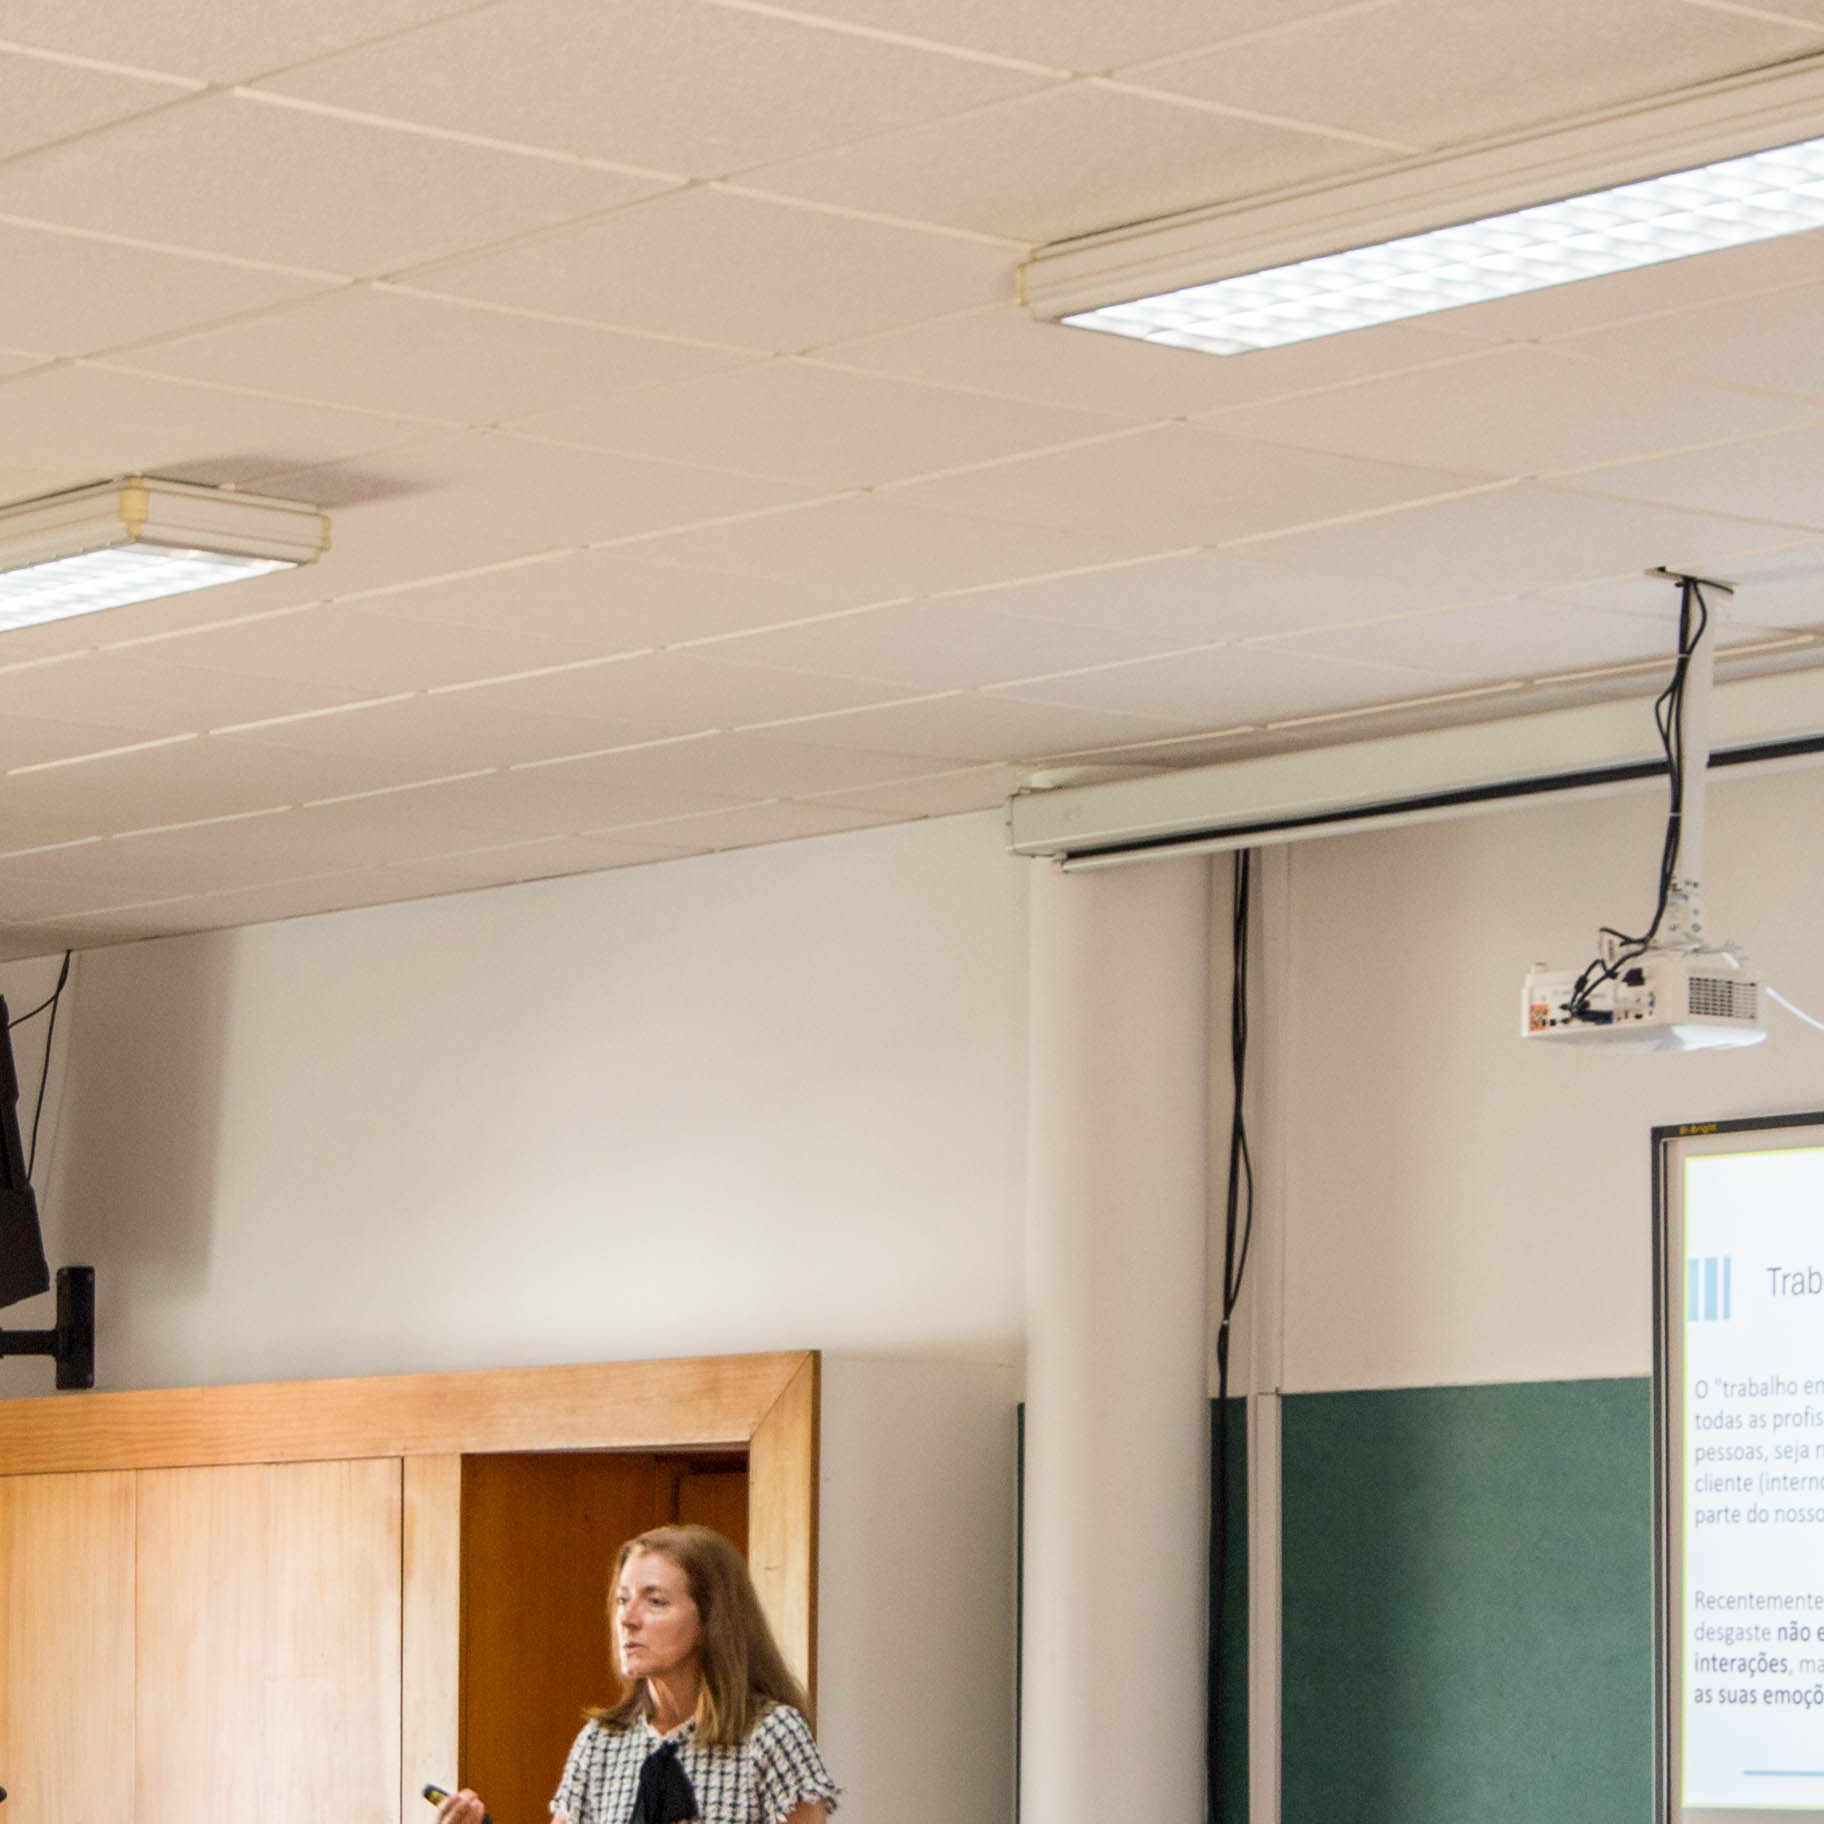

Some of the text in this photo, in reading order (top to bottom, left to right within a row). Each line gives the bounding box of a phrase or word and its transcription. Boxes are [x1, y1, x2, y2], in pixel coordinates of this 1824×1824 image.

[1694, 1379, 1709, 1400] O
[1694, 1409, 1744, 1431] todas
[1748, 1413, 1768, 1430] as
[1774, 1443, 1810, 1465] seja
[1694, 1472, 1754, 1494] cliente
[1694, 1506, 1742, 1529] parte
[1746, 1503, 1770, 1524] do
[1694, 1589, 1824, 1611] Recentemente
[1693, 1620, 1772, 1647] desgaste
[1776, 1619, 1812, 1643] não
[1693, 1687, 1714, 1705] as
[1717, 1687, 1759, 1706] suas
